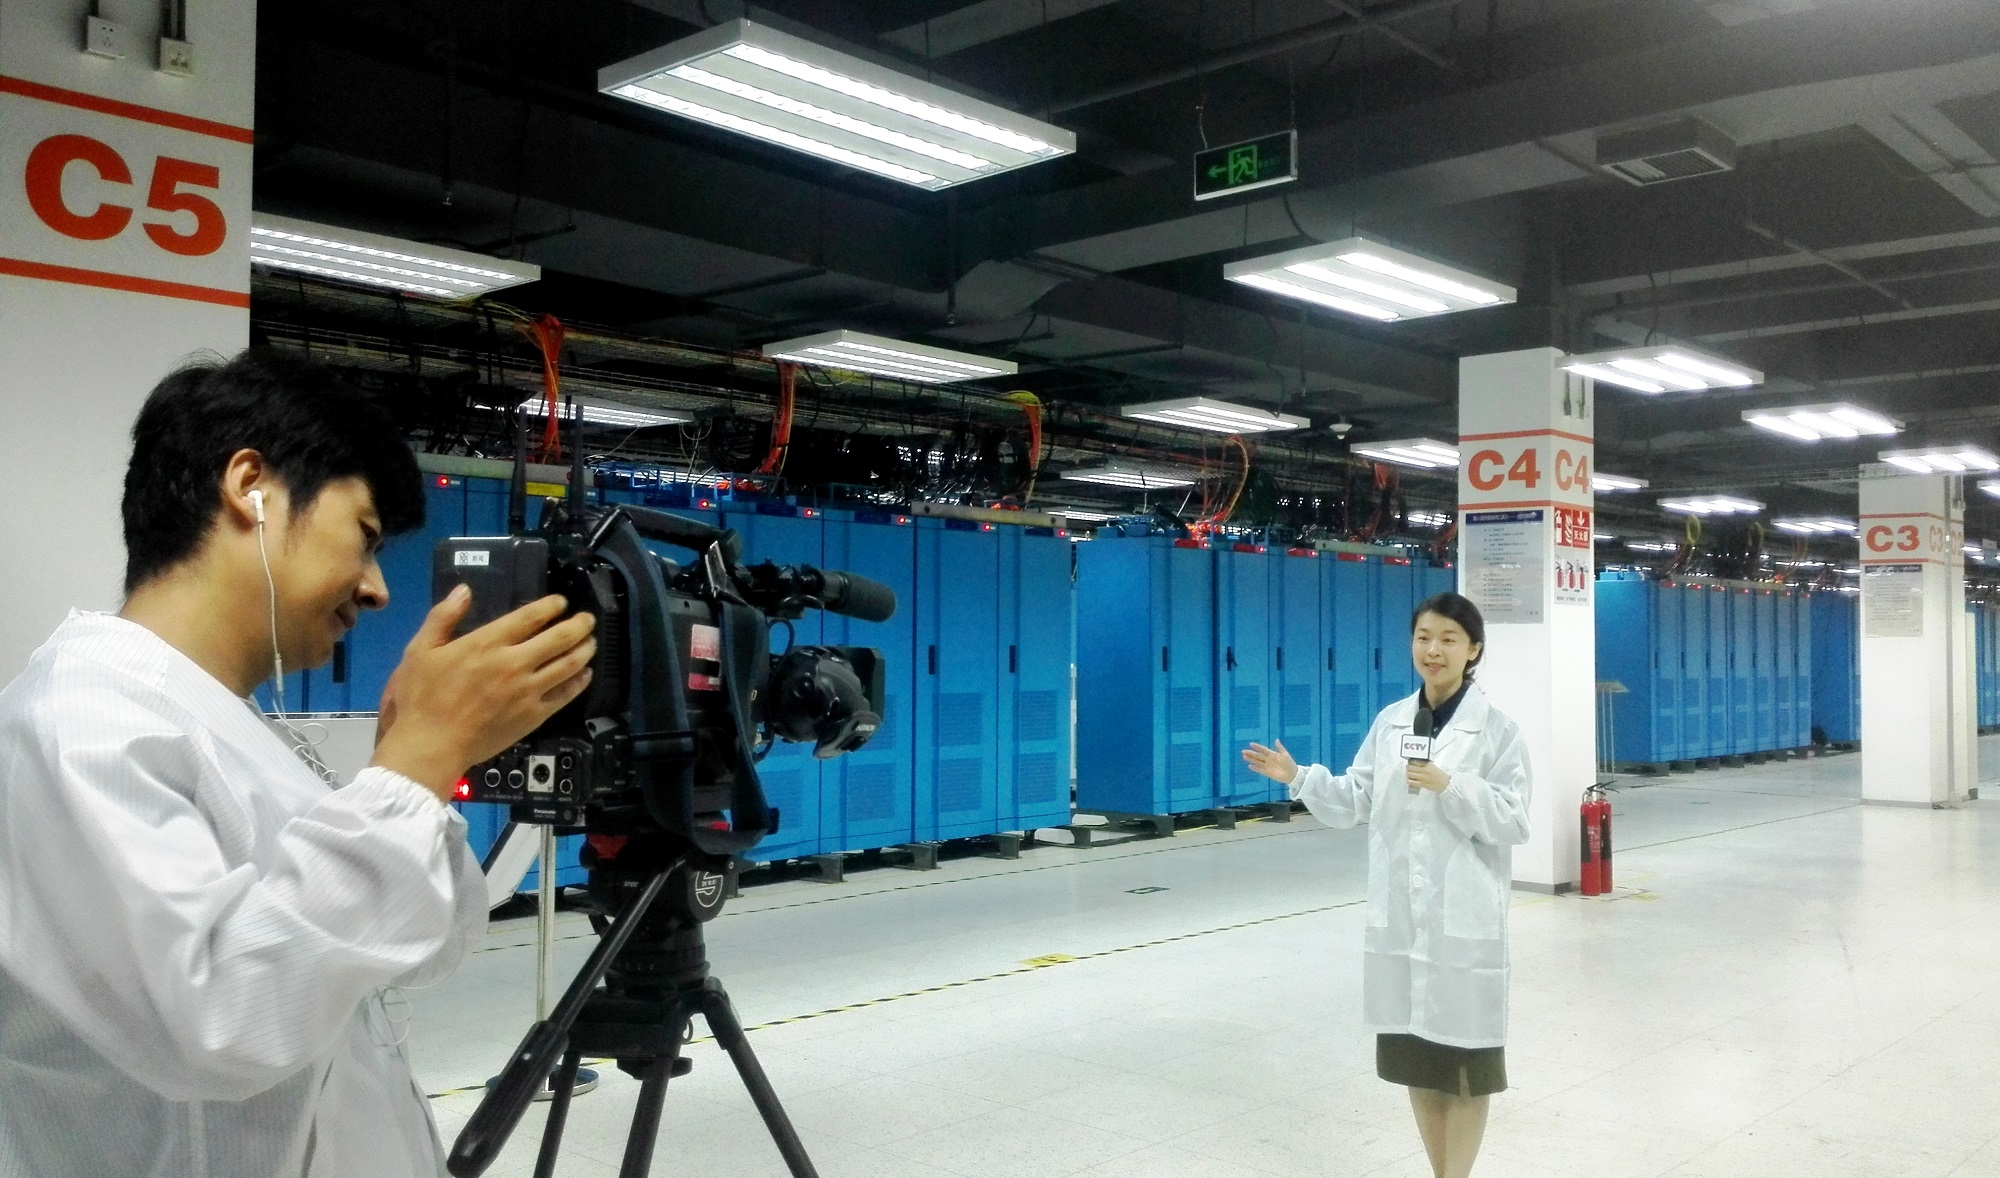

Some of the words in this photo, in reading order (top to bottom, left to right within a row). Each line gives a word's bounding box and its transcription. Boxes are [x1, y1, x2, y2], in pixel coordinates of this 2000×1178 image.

[25, 134, 227, 257] C5
[1467, 448, 1541, 491] C4
[1554, 449, 1589, 494] C4
[1573, 530, 1589, 542] 灭火器
[1865, 525, 1920, 552] C3
[1404, 742, 1427, 751] CCTV
